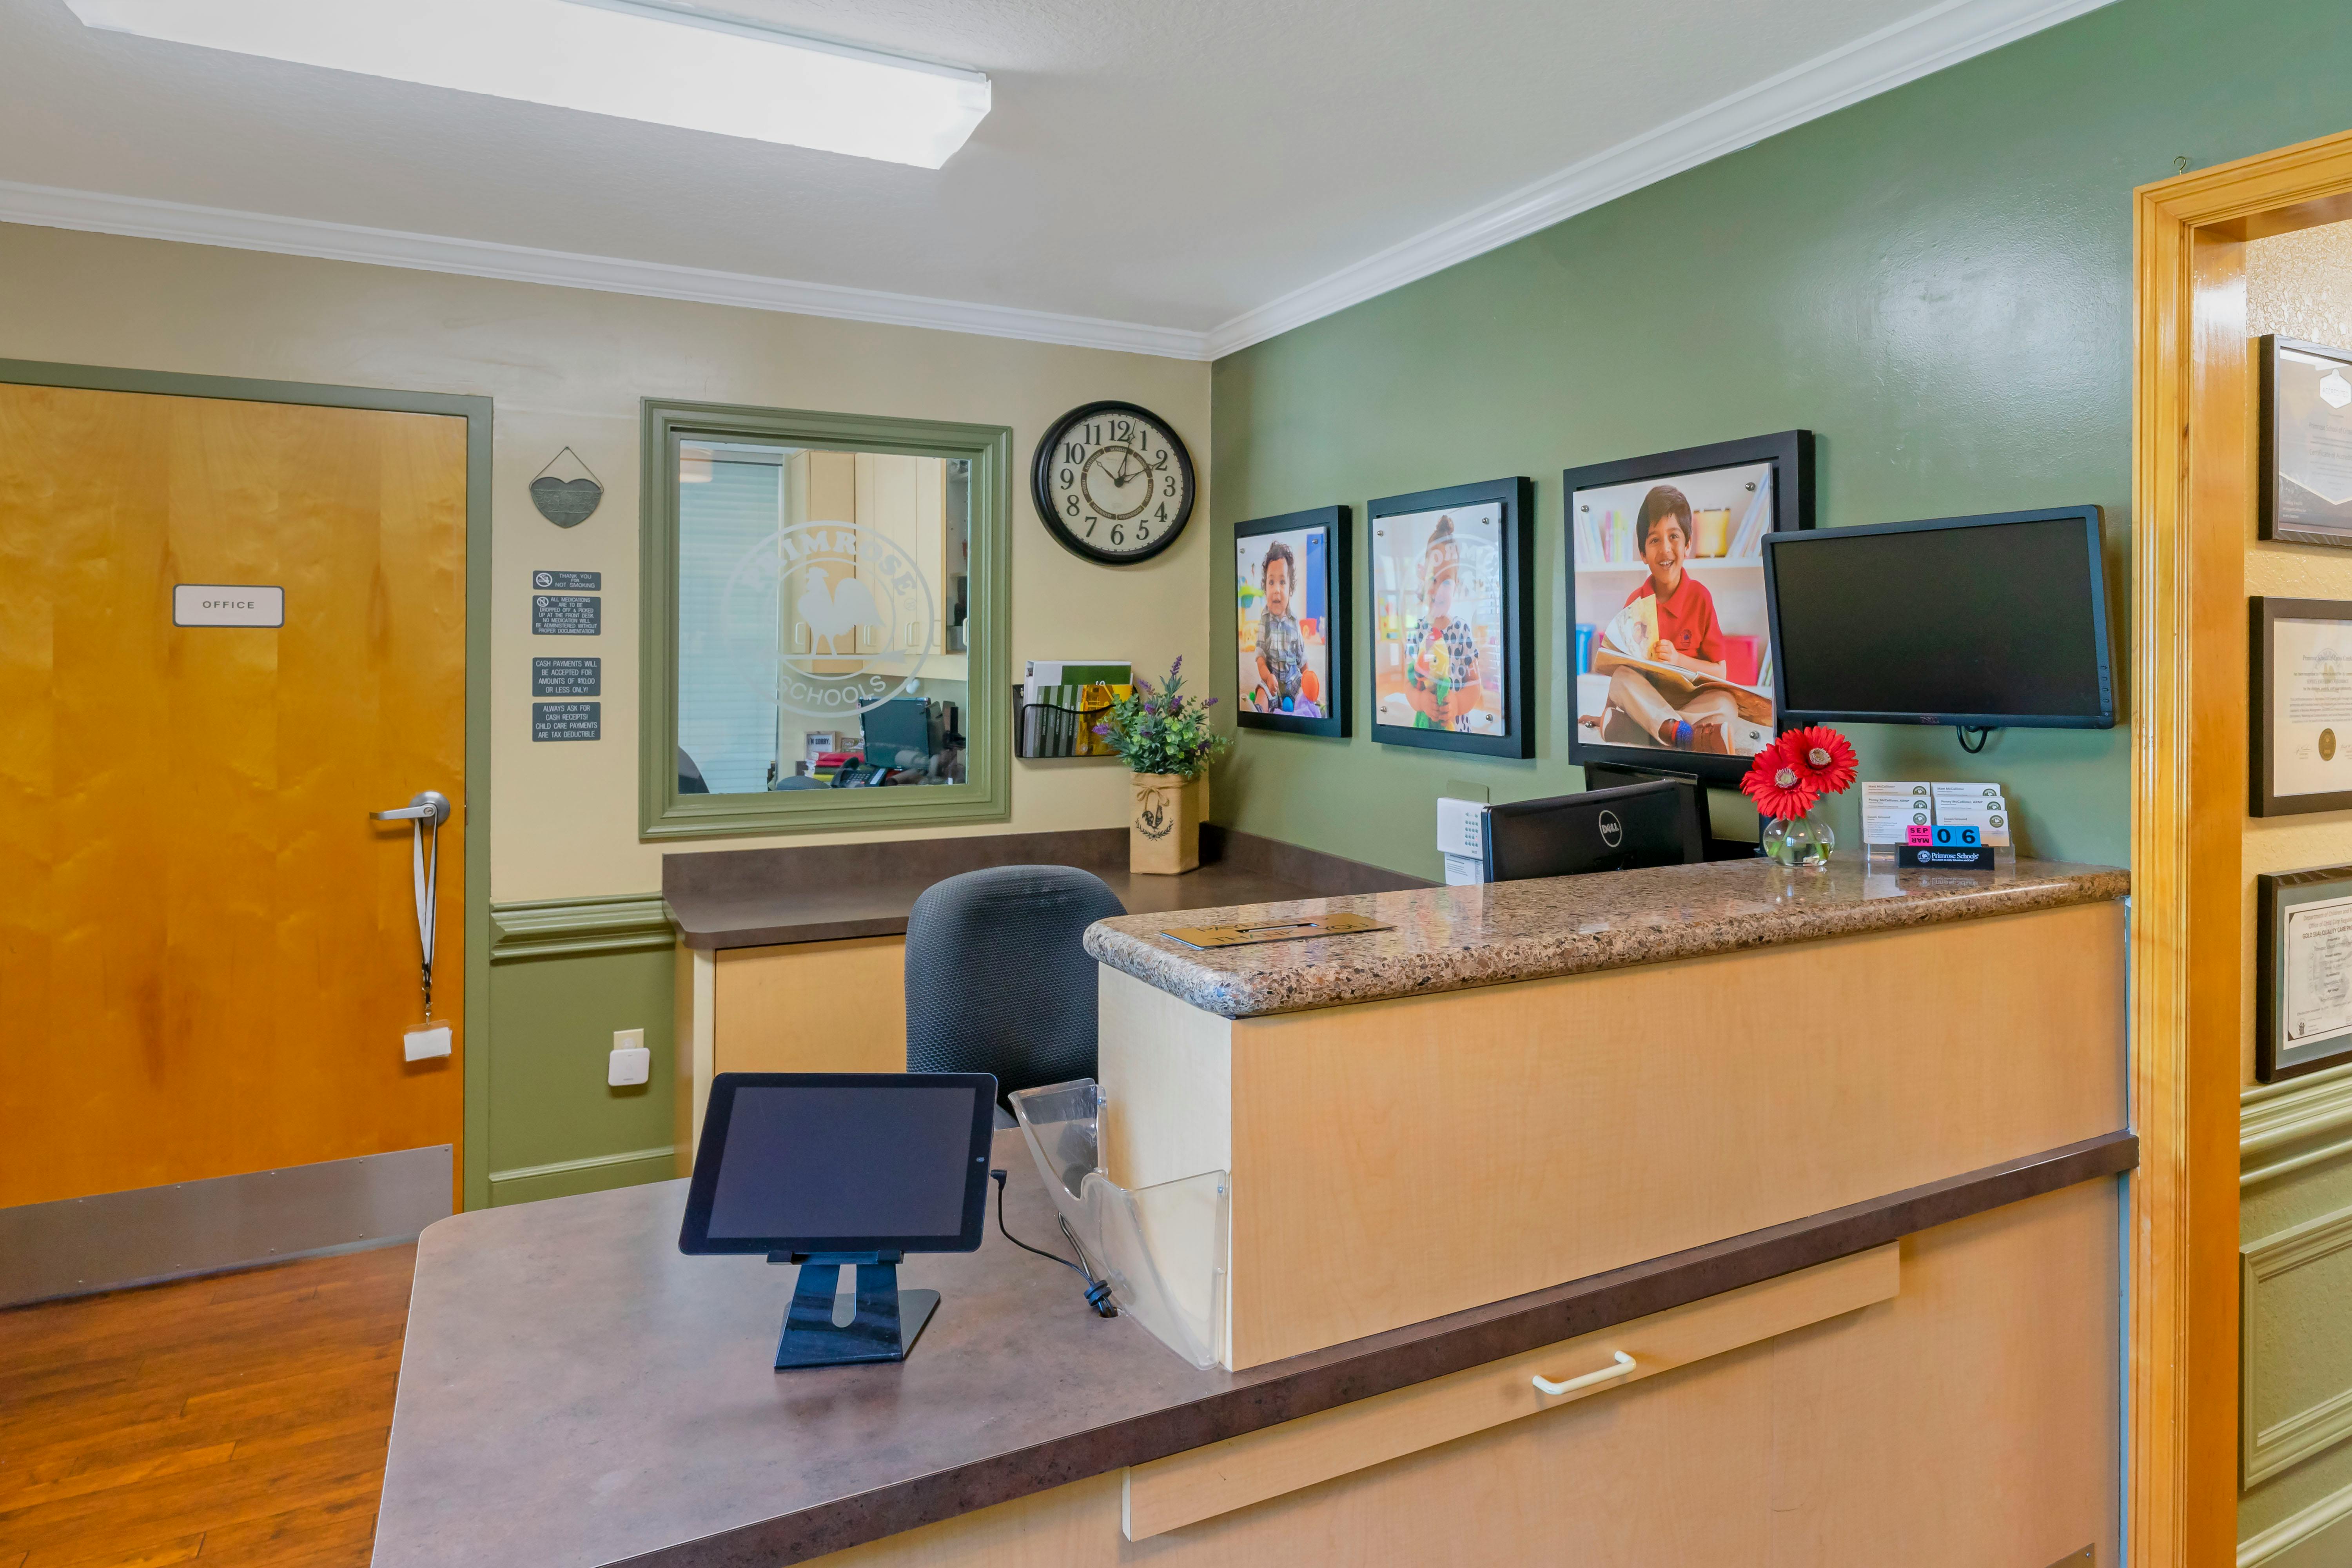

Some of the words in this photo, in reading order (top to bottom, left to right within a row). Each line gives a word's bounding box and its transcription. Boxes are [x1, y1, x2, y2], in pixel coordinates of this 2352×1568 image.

[1084, 424, 1101, 445] 11
[1109, 420, 1132, 442] 12
[1140, 430, 1147, 451] 1
[1064, 442, 1085, 464] 10
[1155, 450, 1168, 471] 2
[1060, 468, 1074, 490] 9
[1163, 476, 1175, 497] 3
[1067, 495, 1080, 516] 8
[1154, 501, 1167, 523] 4
[1085, 516, 1097, 537] 7
[1111, 524, 1124, 545] 6
[1136, 520, 1149, 540] 5
[741, 530, 917, 595] PRIMROSE
[776, 675, 887, 707] SCHOOLS
[1602, 823, 1619, 834] DELL
[1207, 929, 1294, 942] THANK
[1319, 923, 1369, 931] YOU
